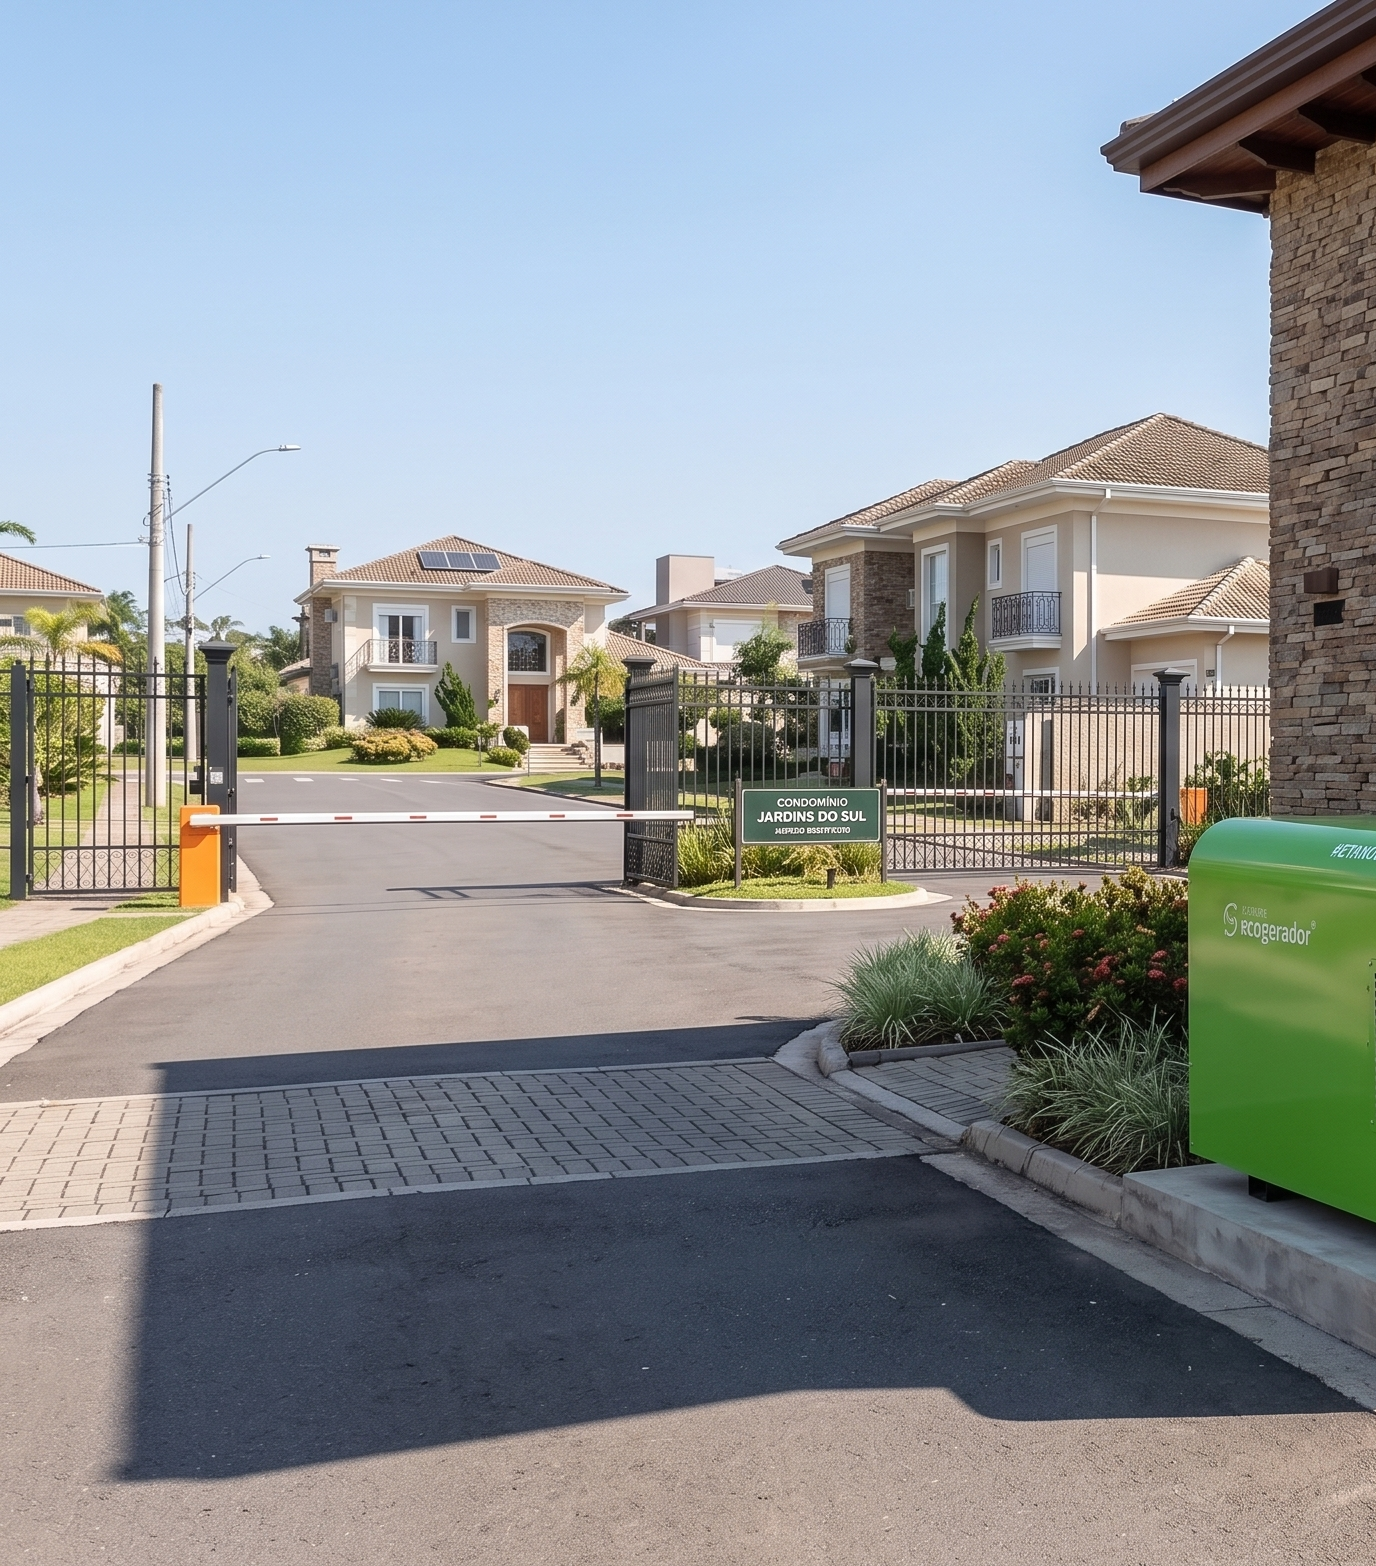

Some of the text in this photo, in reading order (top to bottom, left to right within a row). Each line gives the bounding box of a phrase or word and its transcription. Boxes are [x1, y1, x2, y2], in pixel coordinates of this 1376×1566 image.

[777, 796, 848, 807] CONDOMÍNIO
[757, 810, 867, 823] JARDINS DO SUL
